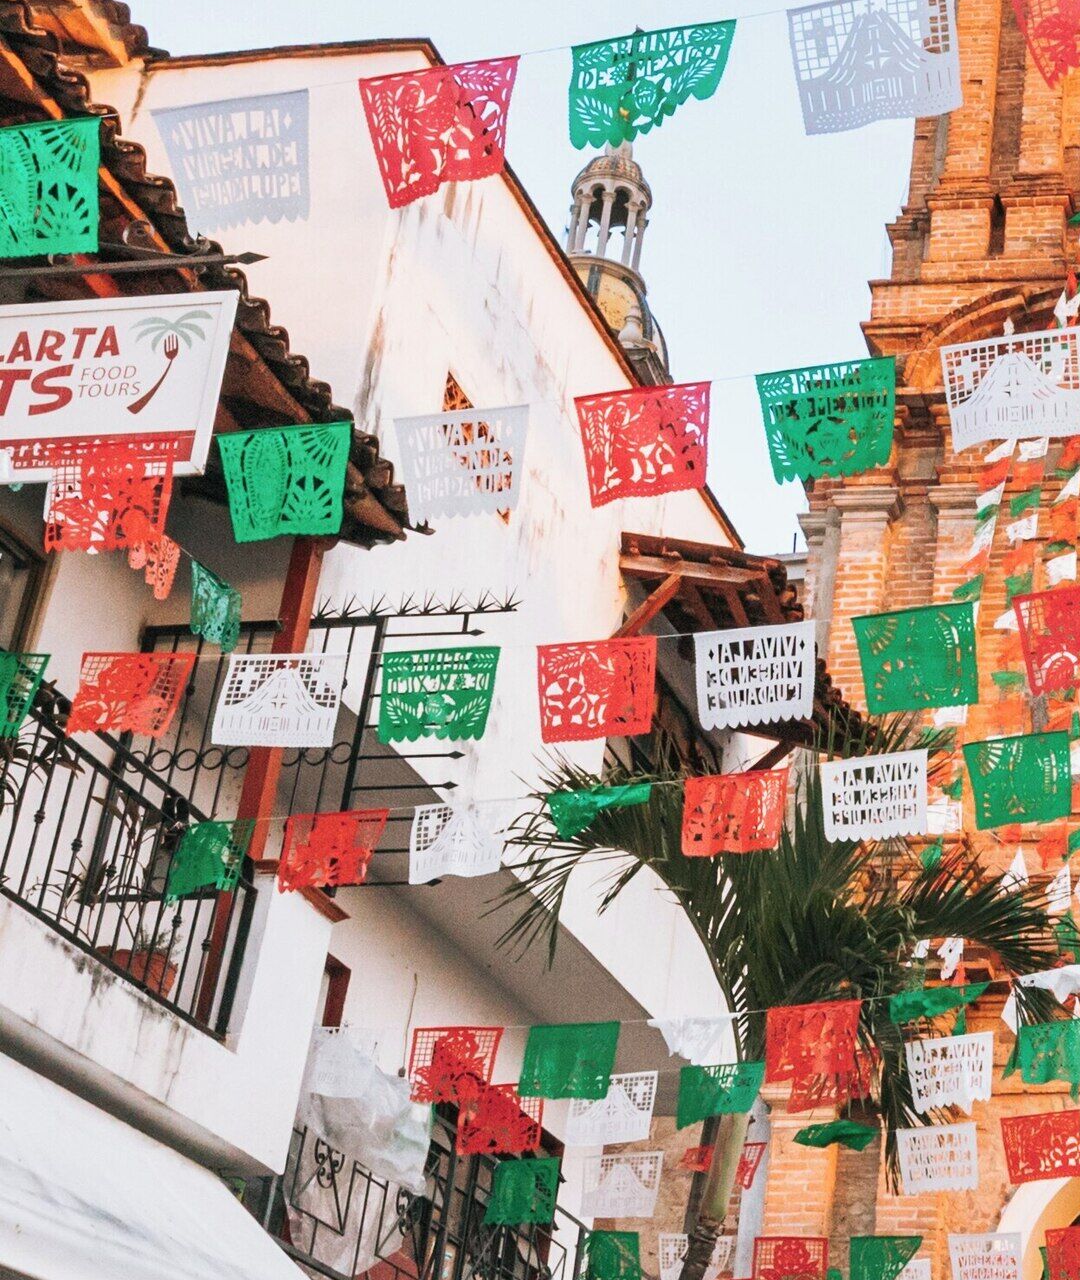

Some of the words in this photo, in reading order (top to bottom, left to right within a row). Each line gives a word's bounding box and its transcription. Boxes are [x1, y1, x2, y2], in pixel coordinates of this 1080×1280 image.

[616, 29, 697, 64] REINA
[577, 63, 602, 91] DE
[632, 46, 722, 81] MEXICO
[178, 114, 238, 148] VIVA
[248, 109, 282, 138] LA
[182, 147, 262, 180] VIRGEN
[271, 141, 300, 167] DE
[78, 381, 141, 399] TOURS
[81, 365, 137, 382] FOOD
